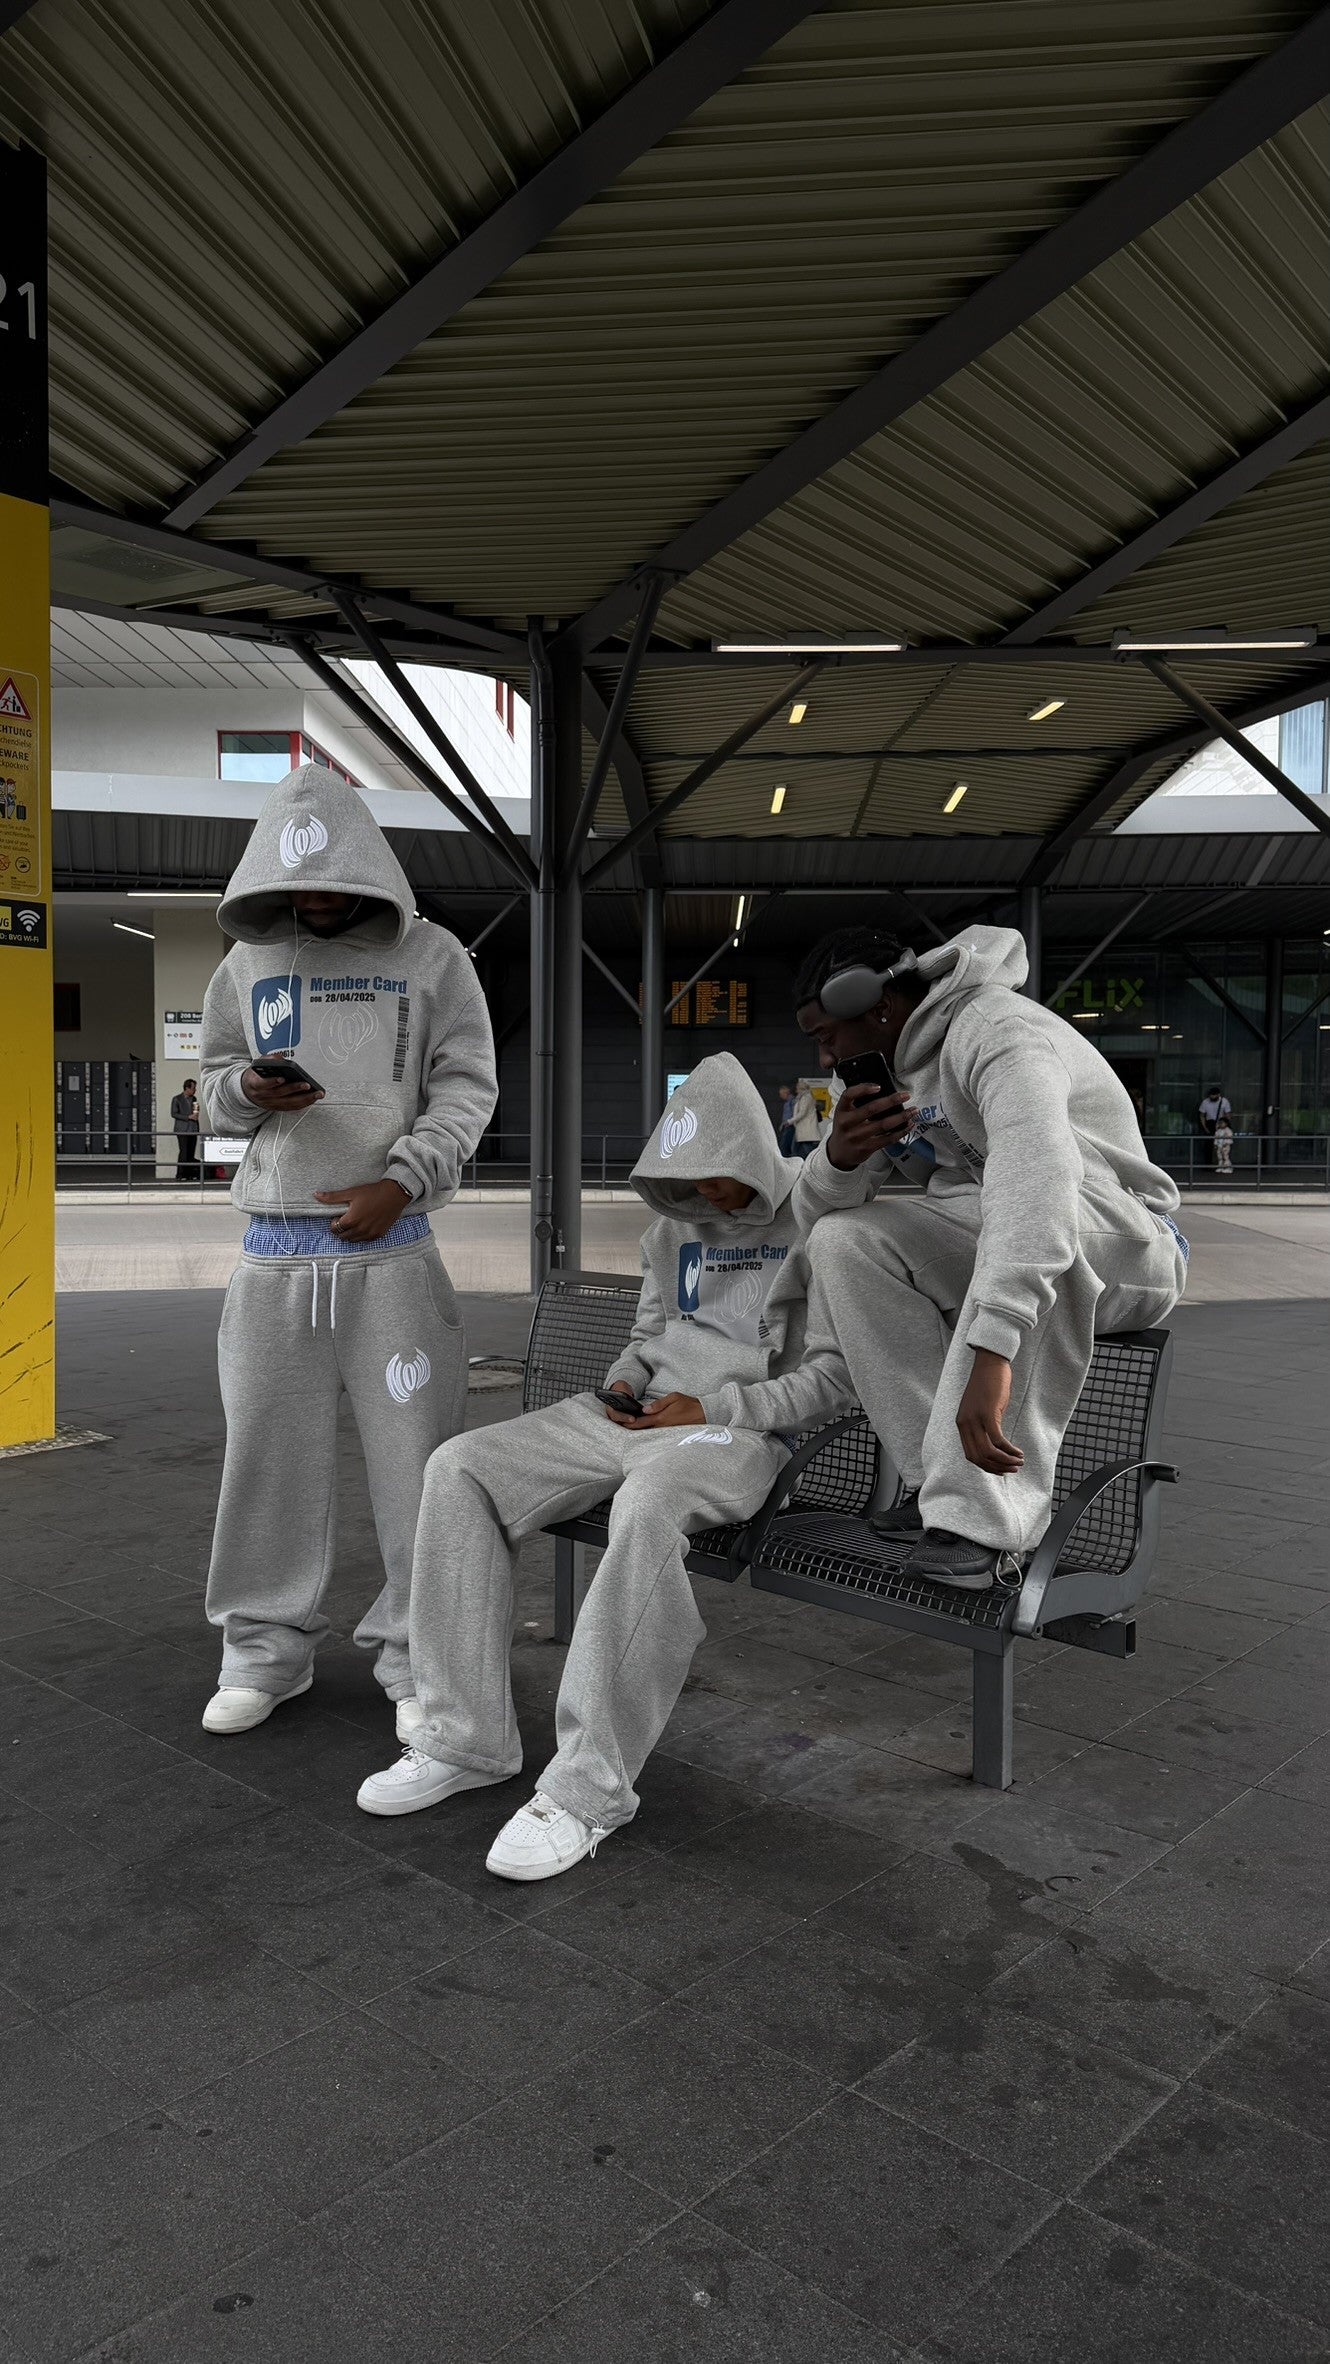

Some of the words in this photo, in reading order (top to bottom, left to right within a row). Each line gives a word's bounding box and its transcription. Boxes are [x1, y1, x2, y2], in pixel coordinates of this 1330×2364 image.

[8, 933, 22, 941] BVG
[23, 935, 39, 943] Wi-Fi
[310, 976, 370, 992] Member
[372, 976, 407, 994] Card
[325, 992, 376, 1003] 28/04/2025
[705, 1246, 758, 1261] Member
[760, 1244, 788, 1260] Card
[717, 1261, 763, 1273] 28/04/2025
